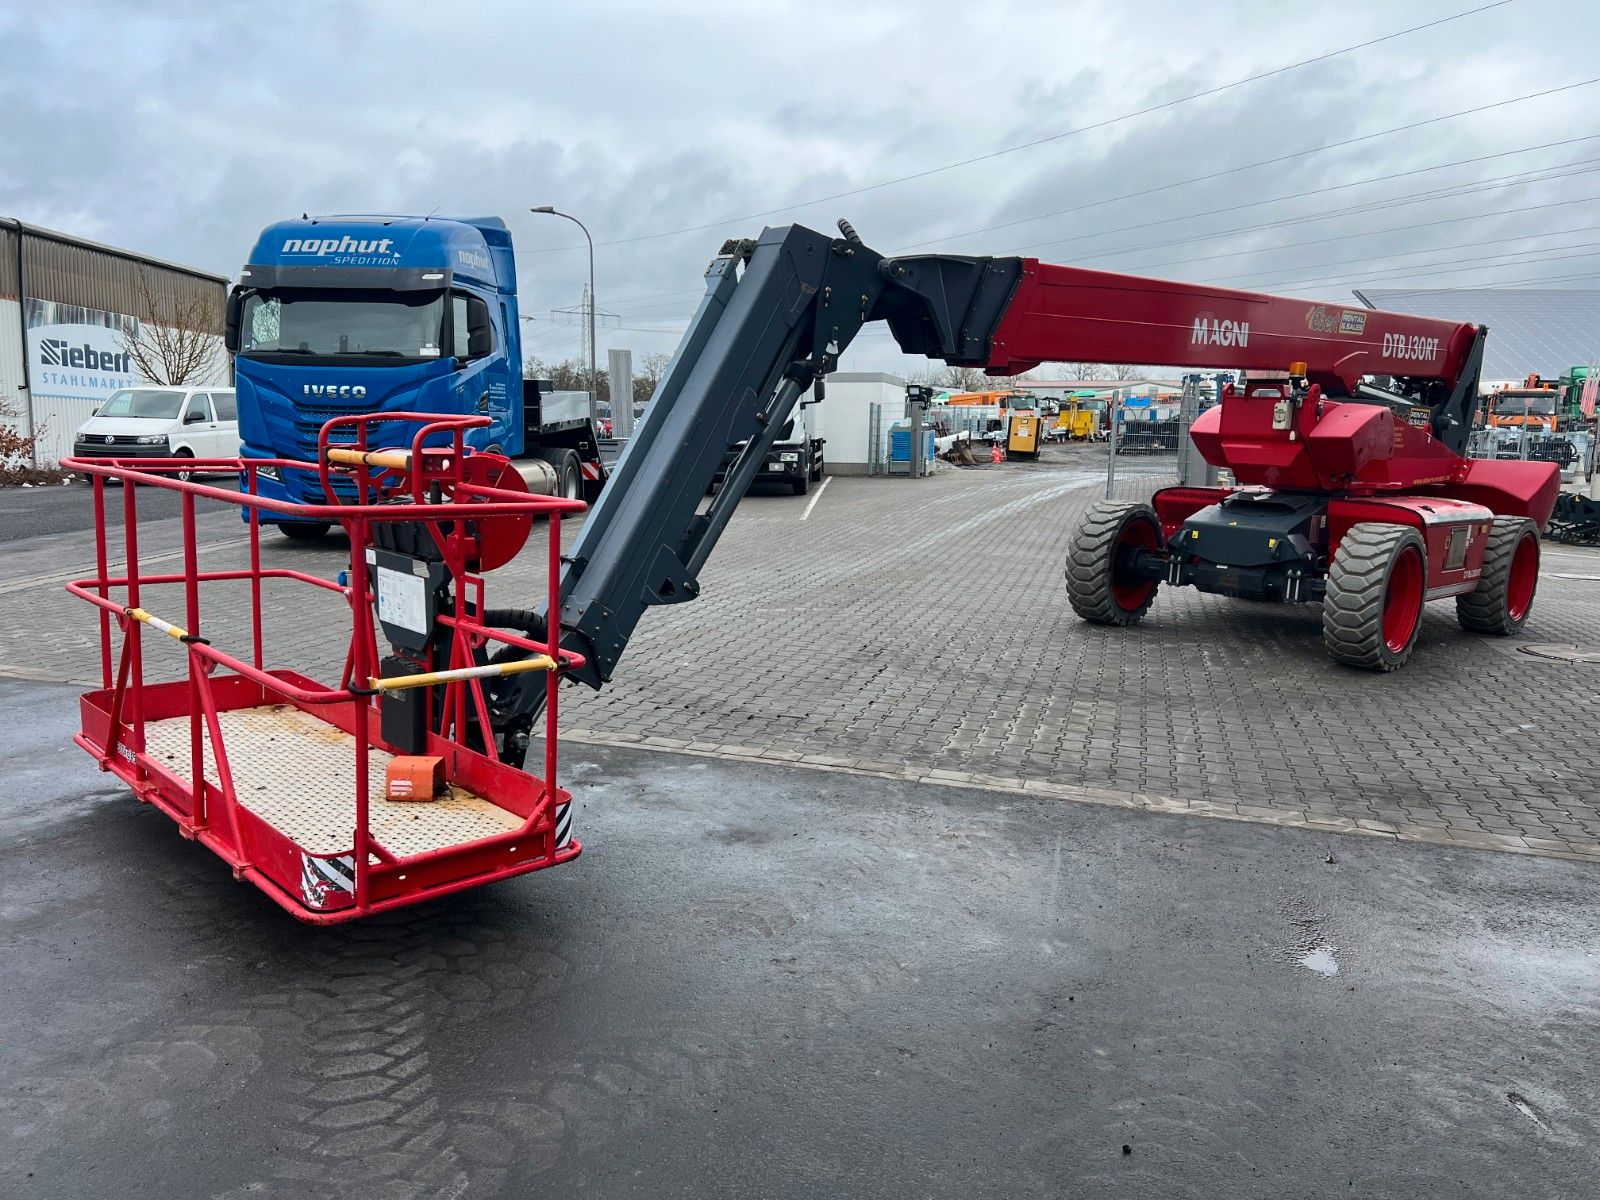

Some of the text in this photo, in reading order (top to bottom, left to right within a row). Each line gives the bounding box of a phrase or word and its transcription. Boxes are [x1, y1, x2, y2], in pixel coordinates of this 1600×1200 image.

[281, 235, 394, 256] nophut
[333, 256, 400, 266] SPEDITION
[1191, 317, 1249, 348] MAGNI
[40, 338, 130, 373] Siebert
[1382, 332, 1440, 361] DTBJ30RT
[42, 372, 133, 390] STAHLMARKT
[303, 384, 367, 399] IVECO
